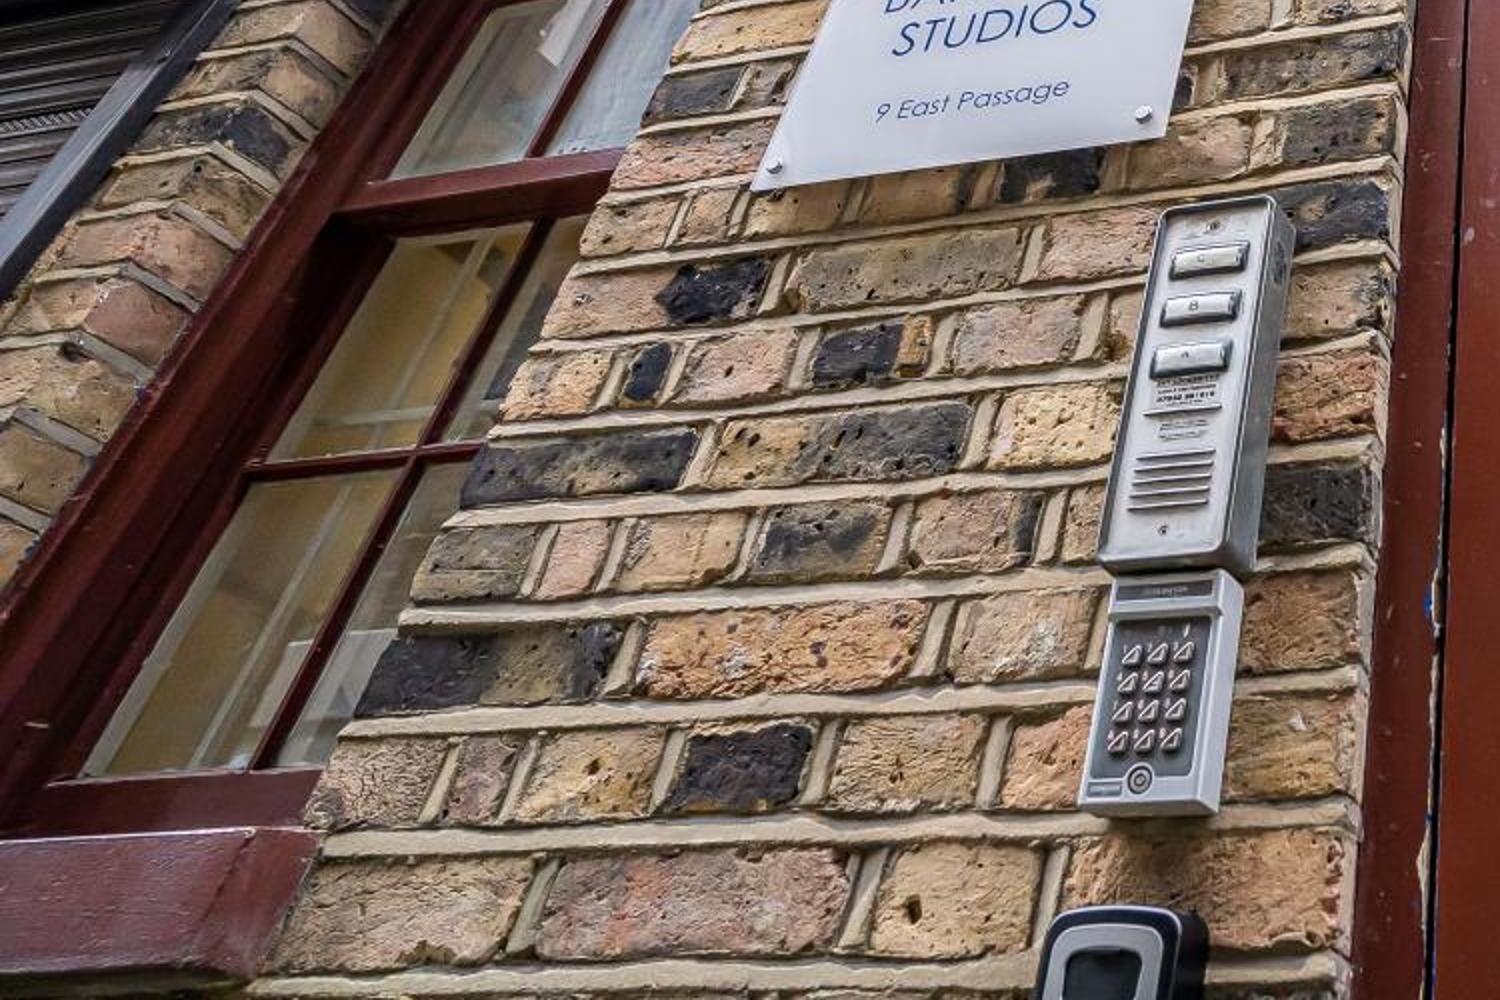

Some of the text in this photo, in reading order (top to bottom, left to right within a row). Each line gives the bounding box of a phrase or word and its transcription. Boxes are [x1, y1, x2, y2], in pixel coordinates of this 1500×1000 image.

[876, 81, 1070, 122] 9 East Passage
[1188, 300, 1199, 311] B
